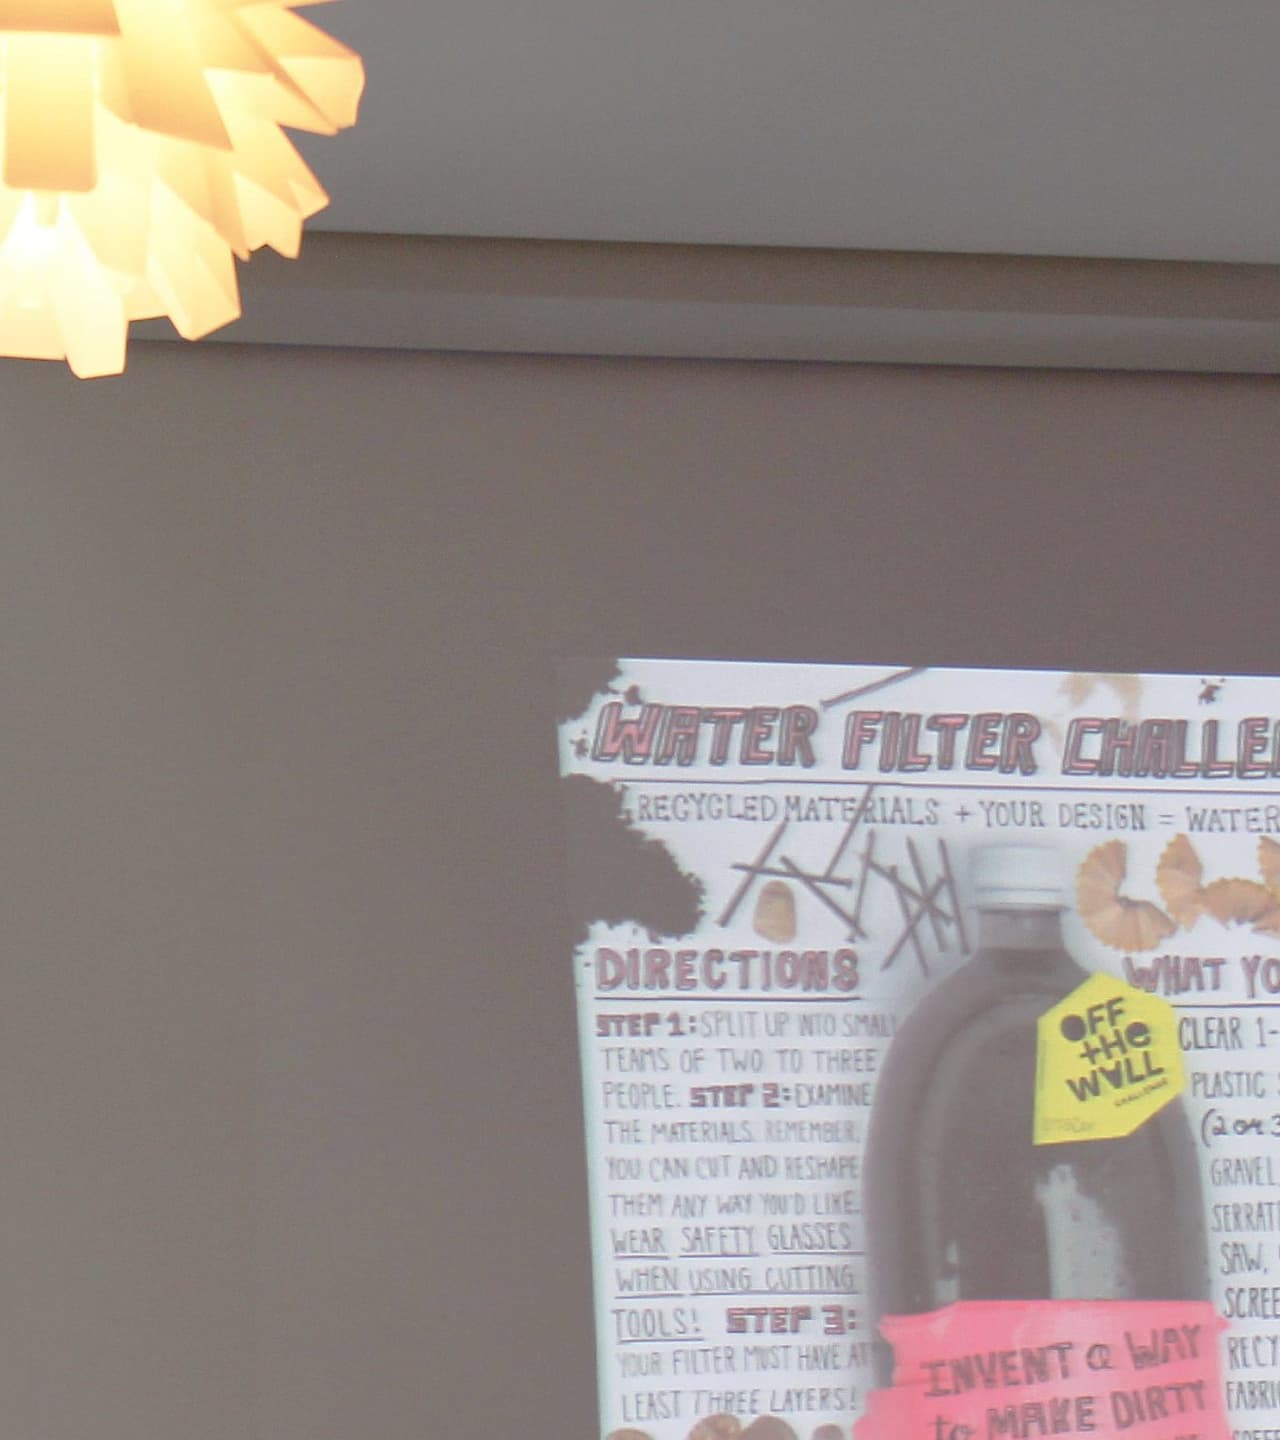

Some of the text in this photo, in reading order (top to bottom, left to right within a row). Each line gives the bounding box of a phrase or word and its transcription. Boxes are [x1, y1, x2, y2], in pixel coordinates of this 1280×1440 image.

[592, 701, 817, 768] WATER
[842, 711, 1042, 776] FILTER
[637, 794, 777, 822] RECYCLED
[784, 795, 939, 826] MATERIALS
[981, 801, 1047, 829] YOUR
[1058, 804, 1146, 831] DESIGN
[595, 947, 860, 992] DIRECTIONS
[1125, 956, 1225, 996] WHAT
[596, 1011, 789, 1037] STEP SPLIT UP
[1061, 996, 1125, 1041] OFF
[1178, 1017, 1243, 1053] CLEAR
[601, 1047, 878, 1073] TEAMS OF TWO TO THREE
[1065, 1051, 1165, 1102] WALL
[690, 1082, 871, 1107] STEP EXAMINE
[1191, 1069, 1265, 1099] PLASTIC
[611, 1223, 851, 1254] WEAR SAFETY GLASSES
[615, 1264, 854, 1293] WHEN USING CUTTING
[726, 1305, 812, 1334] STEP
[673, 1347, 735, 1375] FILTER
[922, 1323, 1204, 1398] INVENT WAY
[622, 1387, 858, 1423] LEAST LAYERS!
[1112, 1379, 1207, 1429] DIRTY
